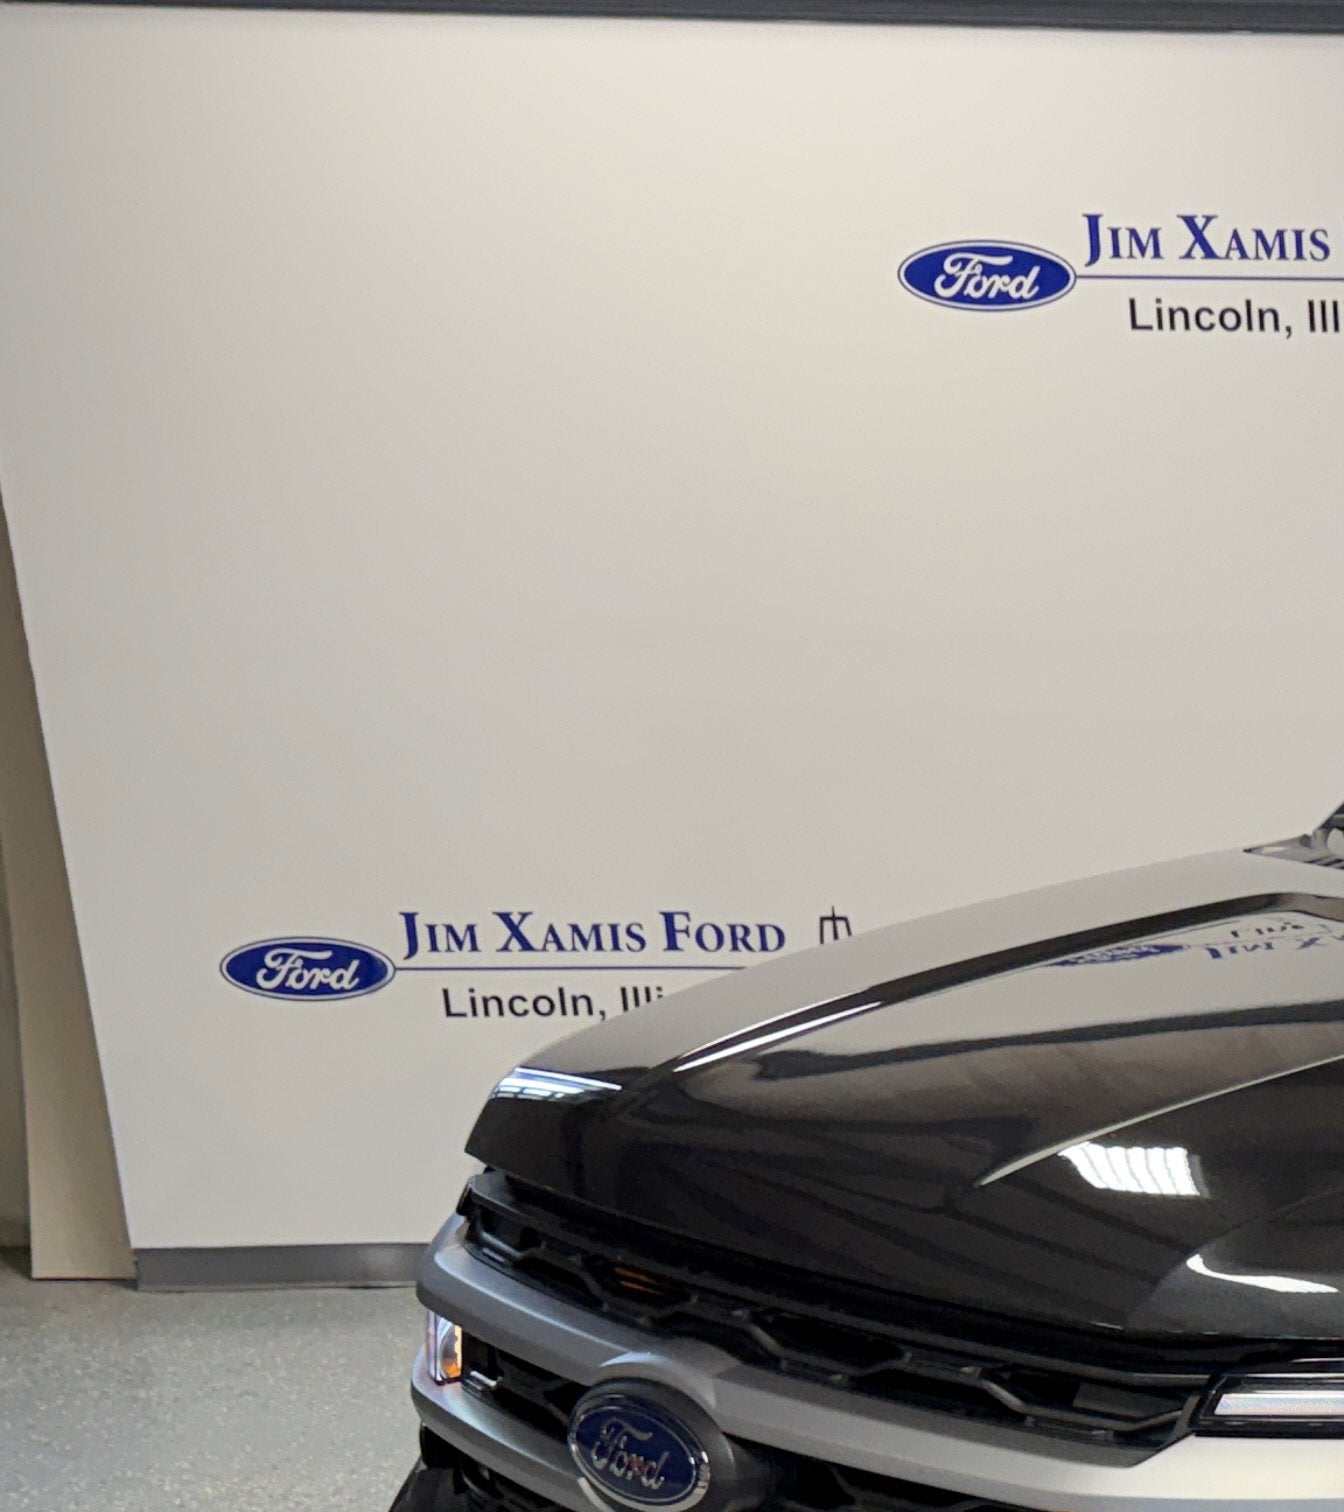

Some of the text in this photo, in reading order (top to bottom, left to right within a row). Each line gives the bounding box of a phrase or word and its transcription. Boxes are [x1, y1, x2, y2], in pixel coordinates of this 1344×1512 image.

[1081, 213, 1165, 268] JIM
[1176, 214, 1331, 263] XAMIS
[933, 253, 1039, 302] Ford
[1128, 297, 1293, 340] Lincoln,
[398, 910, 786, 961] JIM XAMIS FORD
[256, 949, 361, 992] Ford
[441, 986, 607, 1022] Lincoln,
[592, 1416, 670, 1491] Ford
